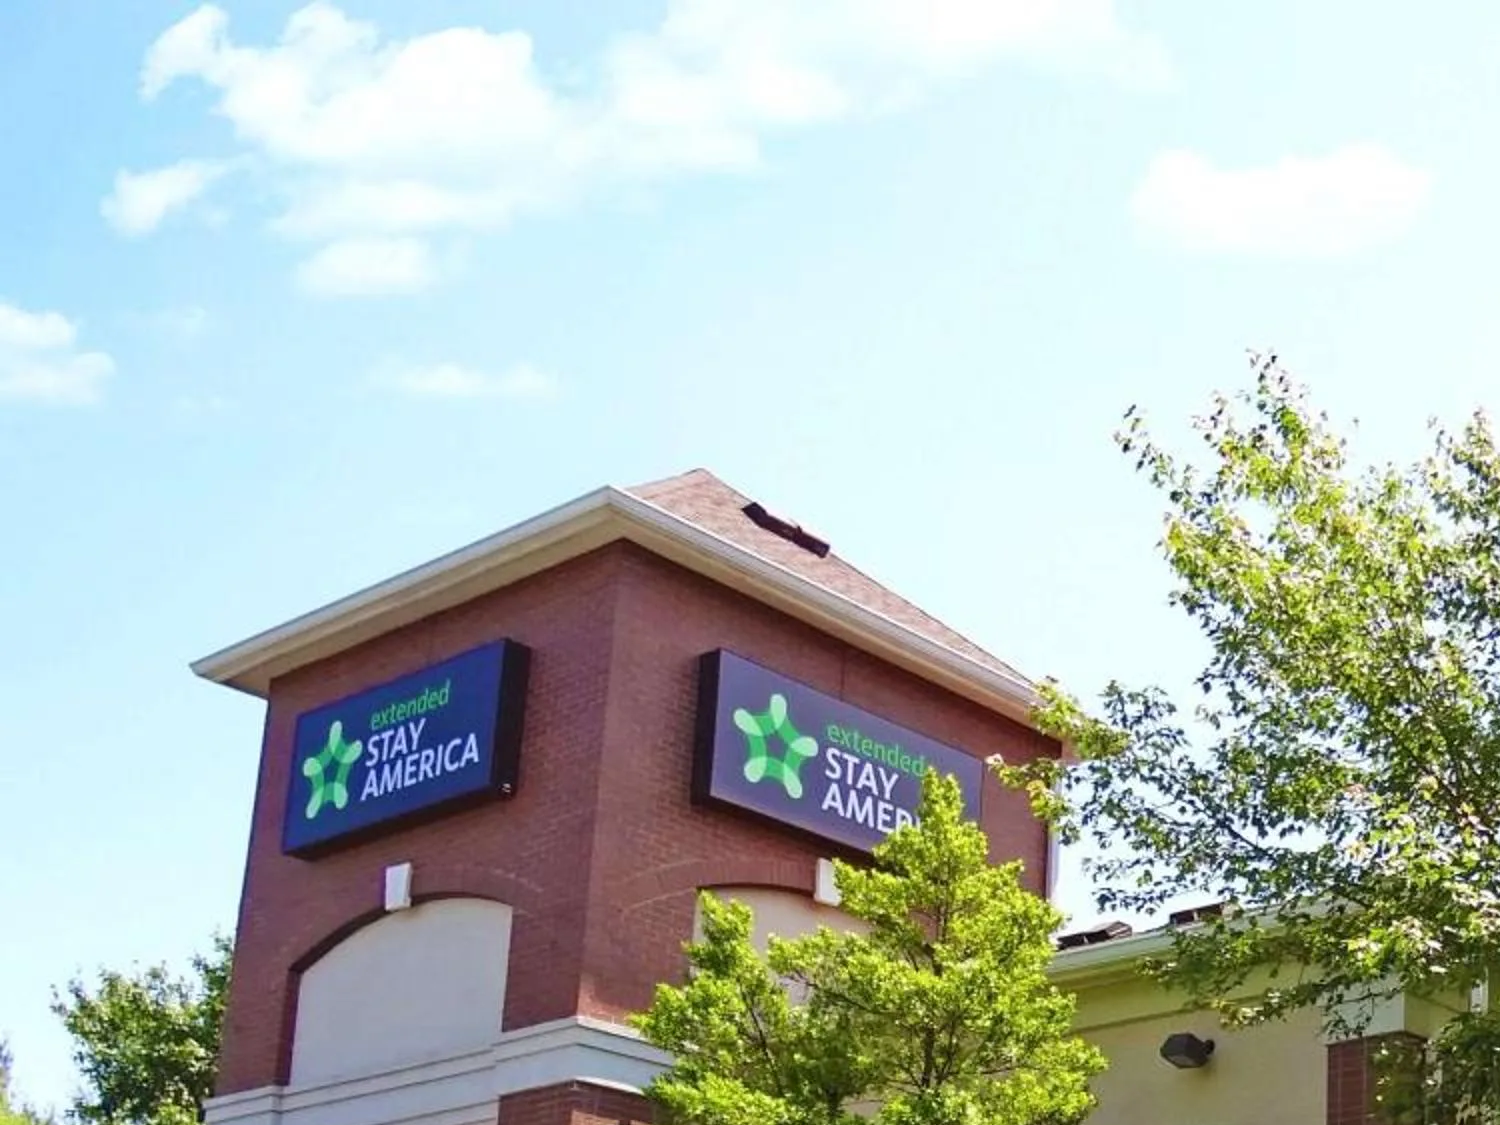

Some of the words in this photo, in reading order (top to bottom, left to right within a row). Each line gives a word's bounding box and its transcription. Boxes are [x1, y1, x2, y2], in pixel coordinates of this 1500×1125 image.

[370, 678, 451, 730] extended
[360, 733, 480, 801] AMERICA
[365, 718, 426, 767] STAY
[827, 724, 926, 777] extended
[824, 747, 899, 801] STAY
